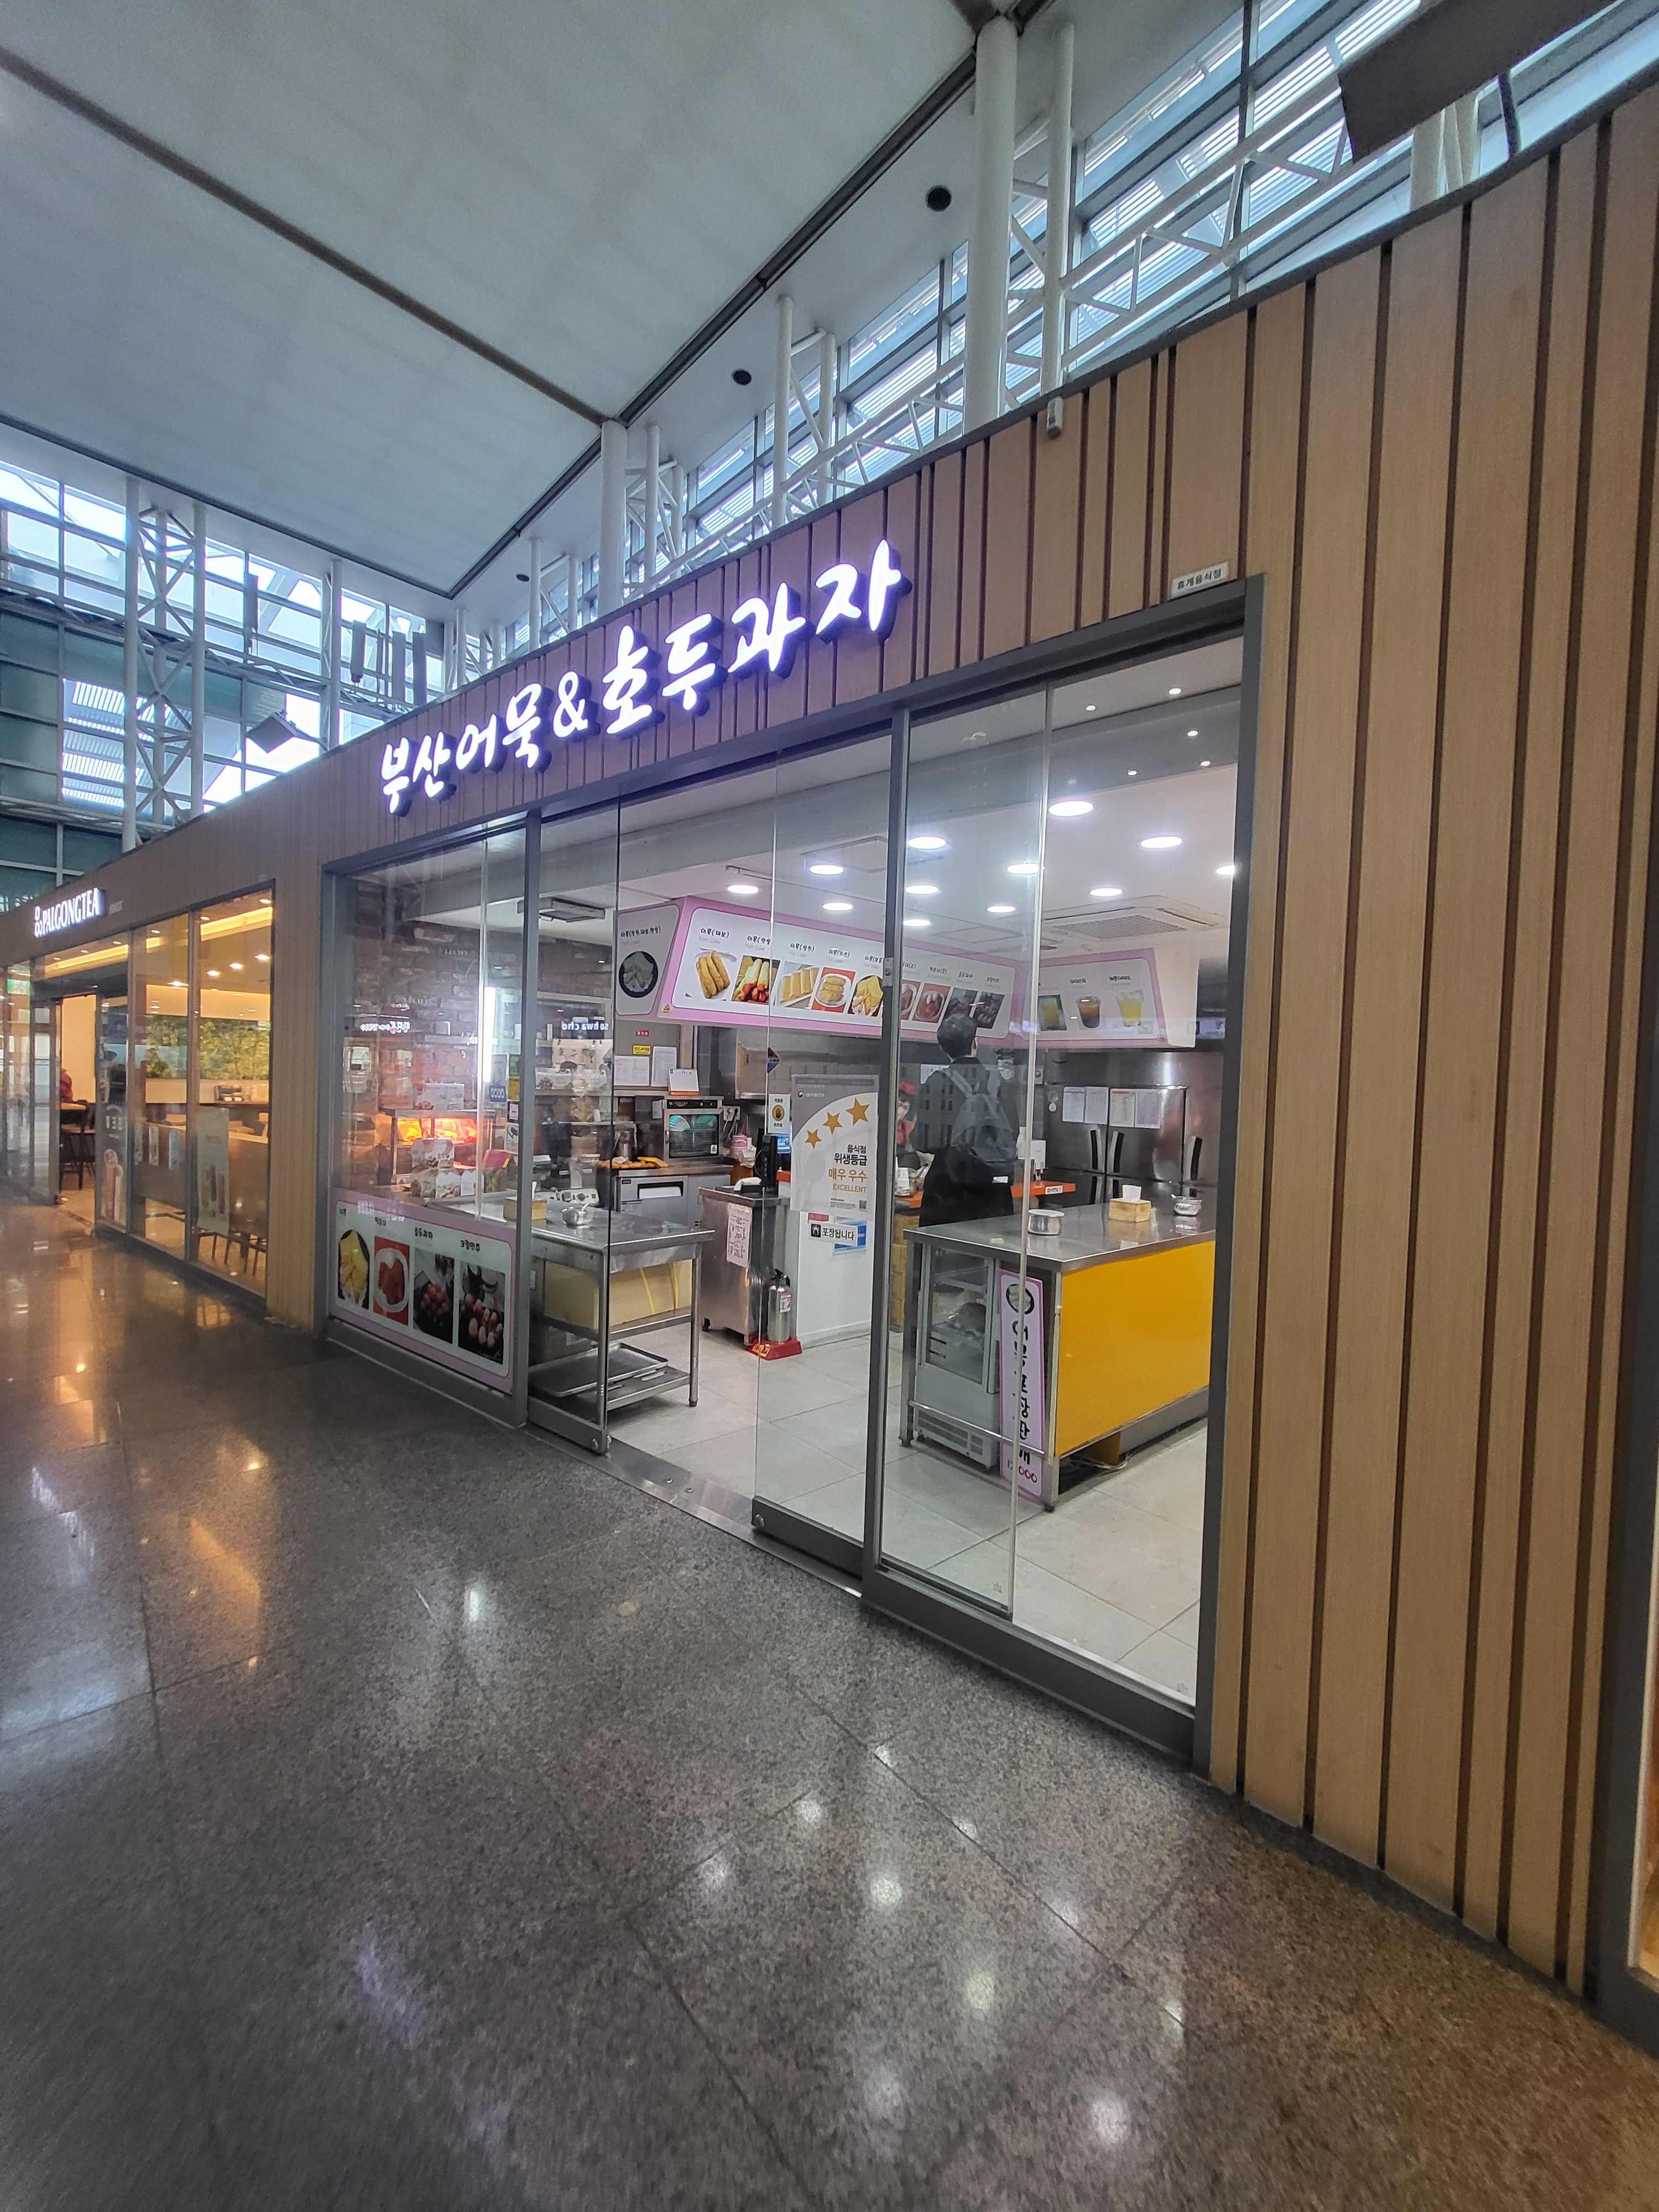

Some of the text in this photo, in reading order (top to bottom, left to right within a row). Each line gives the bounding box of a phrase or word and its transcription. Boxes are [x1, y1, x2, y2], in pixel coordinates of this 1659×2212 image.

[1177, 568, 1222, 590] 휴게음식점
[42, 887, 99, 935] PALGONGTEA
[700, 927, 729, 938] 어묵(대보)
[847, 1144, 867, 1154] 음식점
[834, 1153, 867, 1166] 위생등급
[828, 1168, 867, 1182] 매우 우수
[833, 1183, 867, 1193] EXCELLENT
[415, 1227, 433, 1239] 호두과자
[822, 1228, 854, 1241] 포장됩니다
